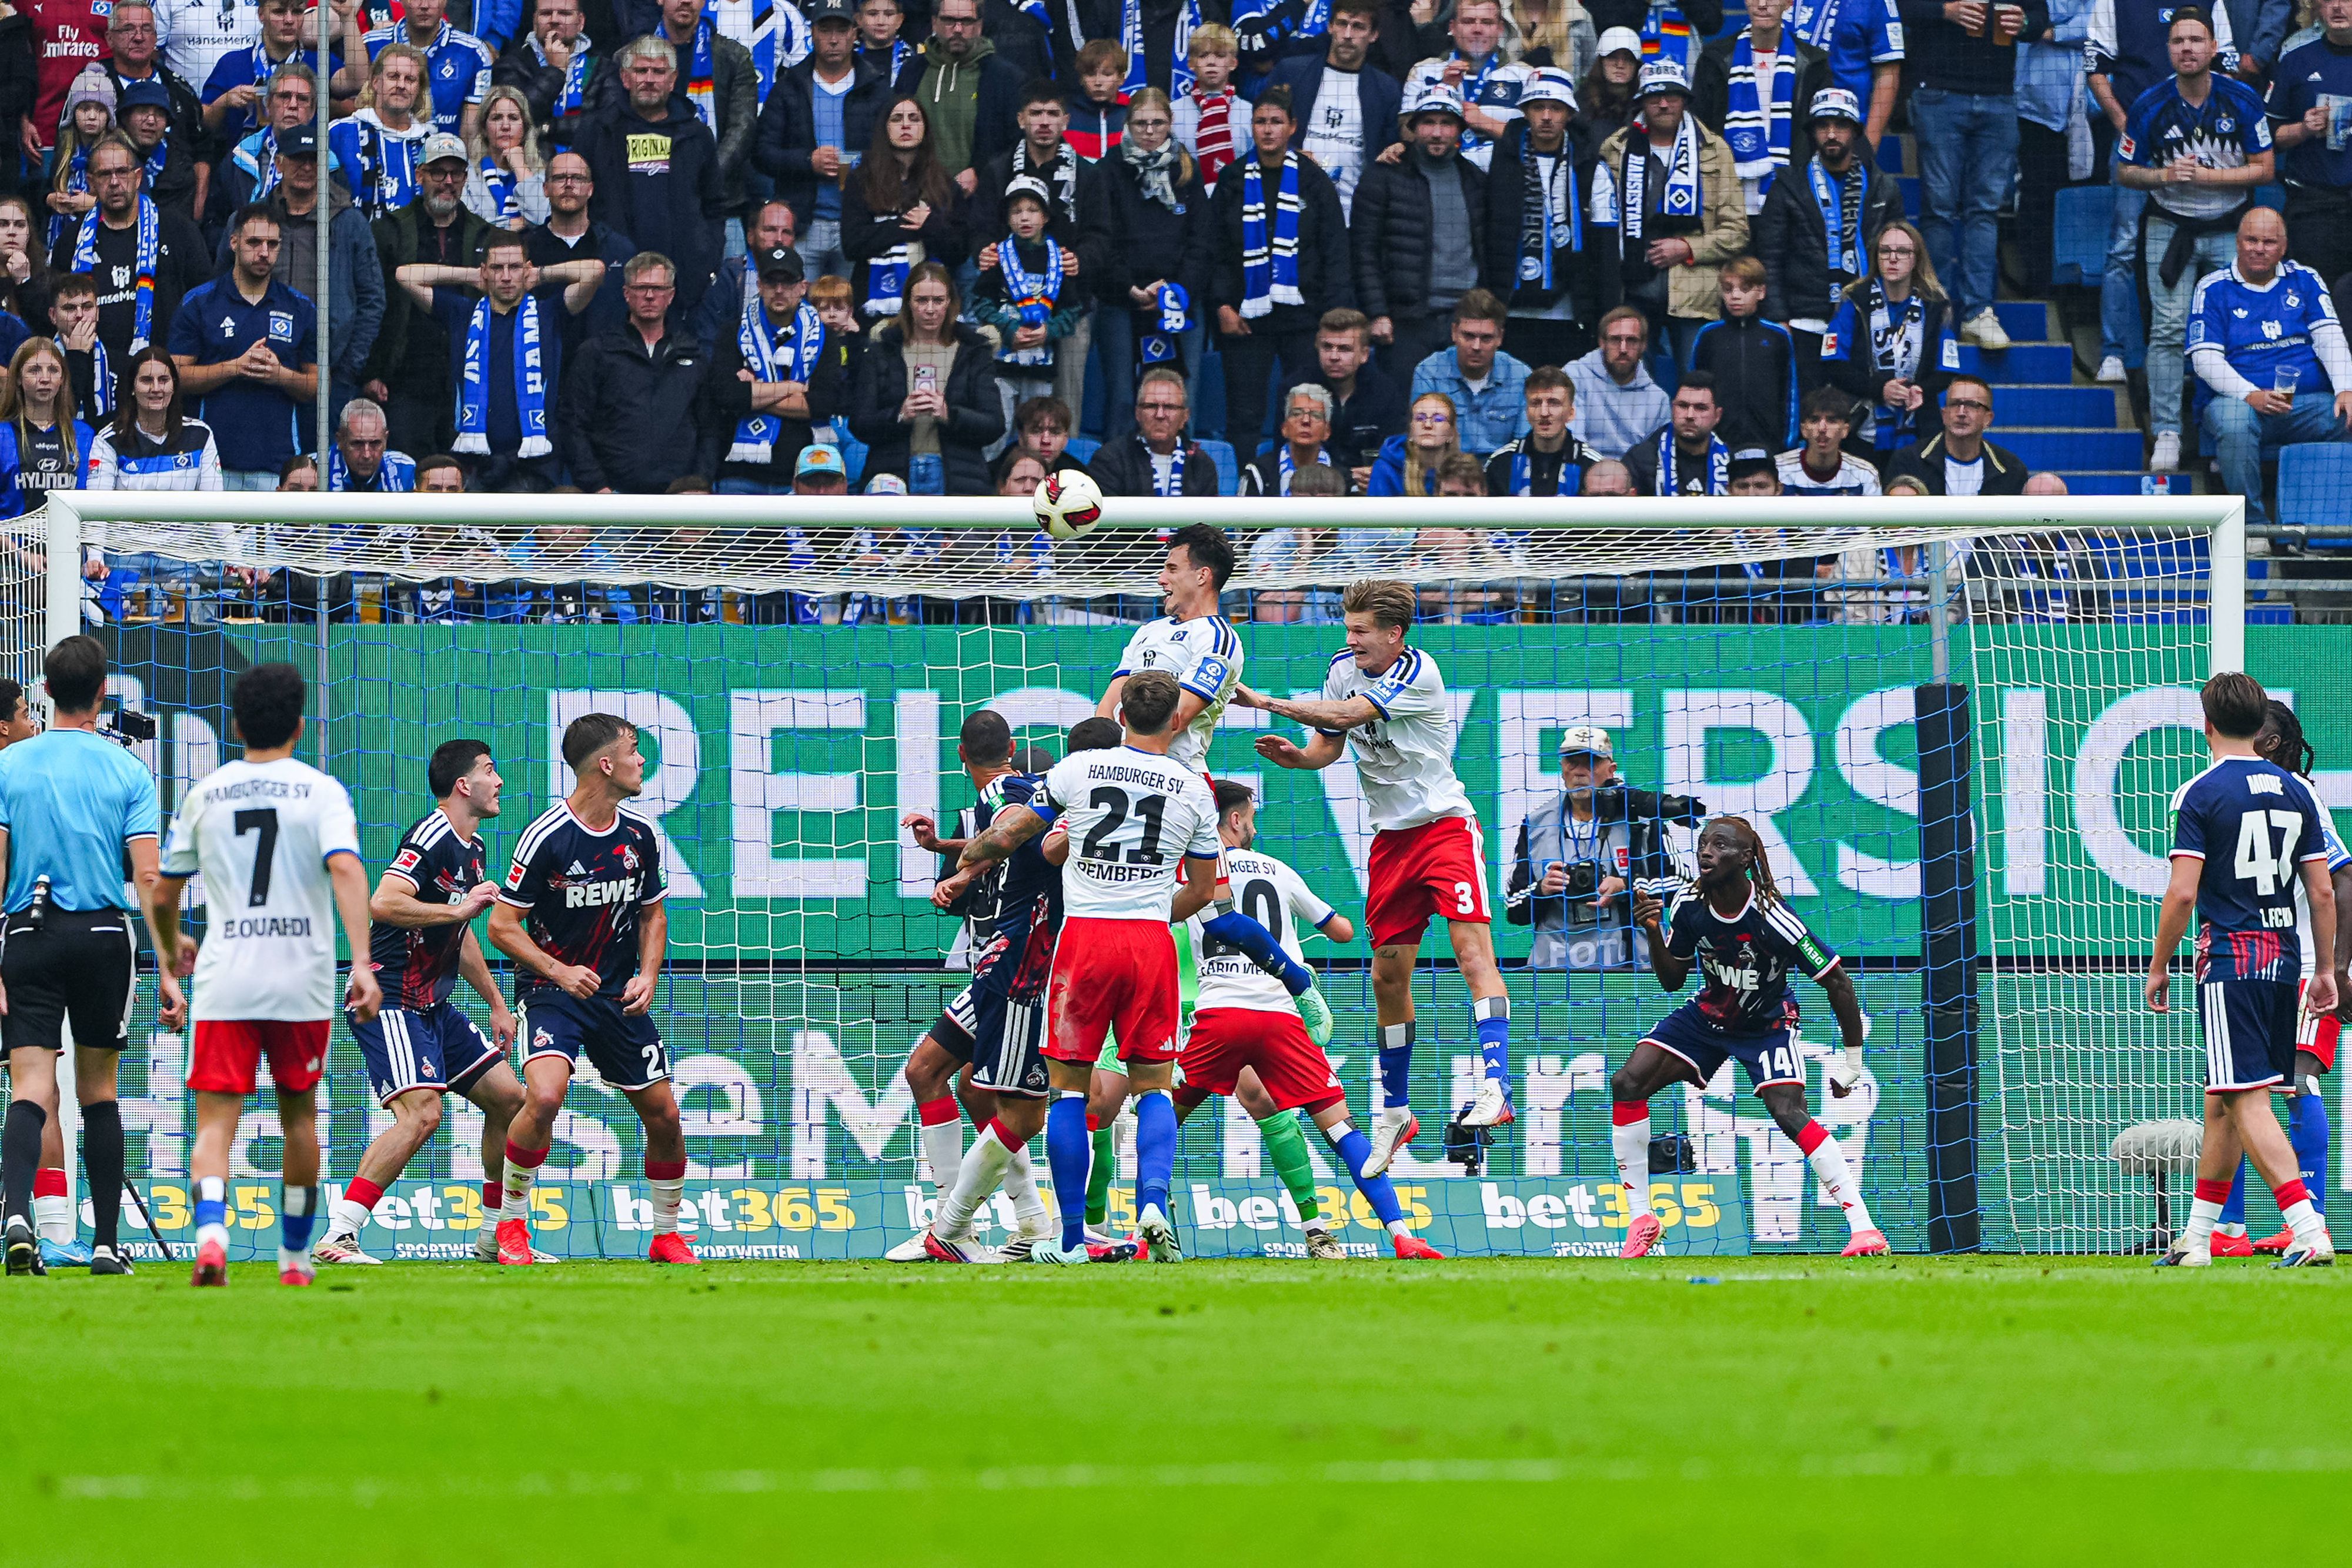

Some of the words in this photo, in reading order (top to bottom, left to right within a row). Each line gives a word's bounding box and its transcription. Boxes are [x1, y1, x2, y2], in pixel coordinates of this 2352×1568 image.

[58, 24, 79, 41] Fly
[1625, 154, 1645, 238] HANSESTADT
[96, 289, 136, 305] anseMe
[547, 687, 2352, 898] REIVERSIC
[1088, 764, 1165, 789] HAMBURGER
[1167, 777, 1184, 794] SV
[1081, 786, 1167, 865] 21
[234, 808, 279, 907] 7
[1230, 859, 1262, 876] RGER
[1263, 862, 1276, 877] SV
[2234, 809, 2303, 896] 47
[566, 878, 636, 908] REWE
[1454, 882, 1475, 915] 3
[1800, 939, 1825, 966] DEVK
[1758, 1047, 1792, 1080] 14
[612, 1185, 856, 1232] bet365
[904, 1184, 1138, 1233] bet5
[1190, 1183, 1434, 1230] bet365
[1481, 1182, 1720, 1228] bet365
[116, 1242, 199, 1259] PORTWETT
[396, 1242, 476, 1259] SPORTWE
